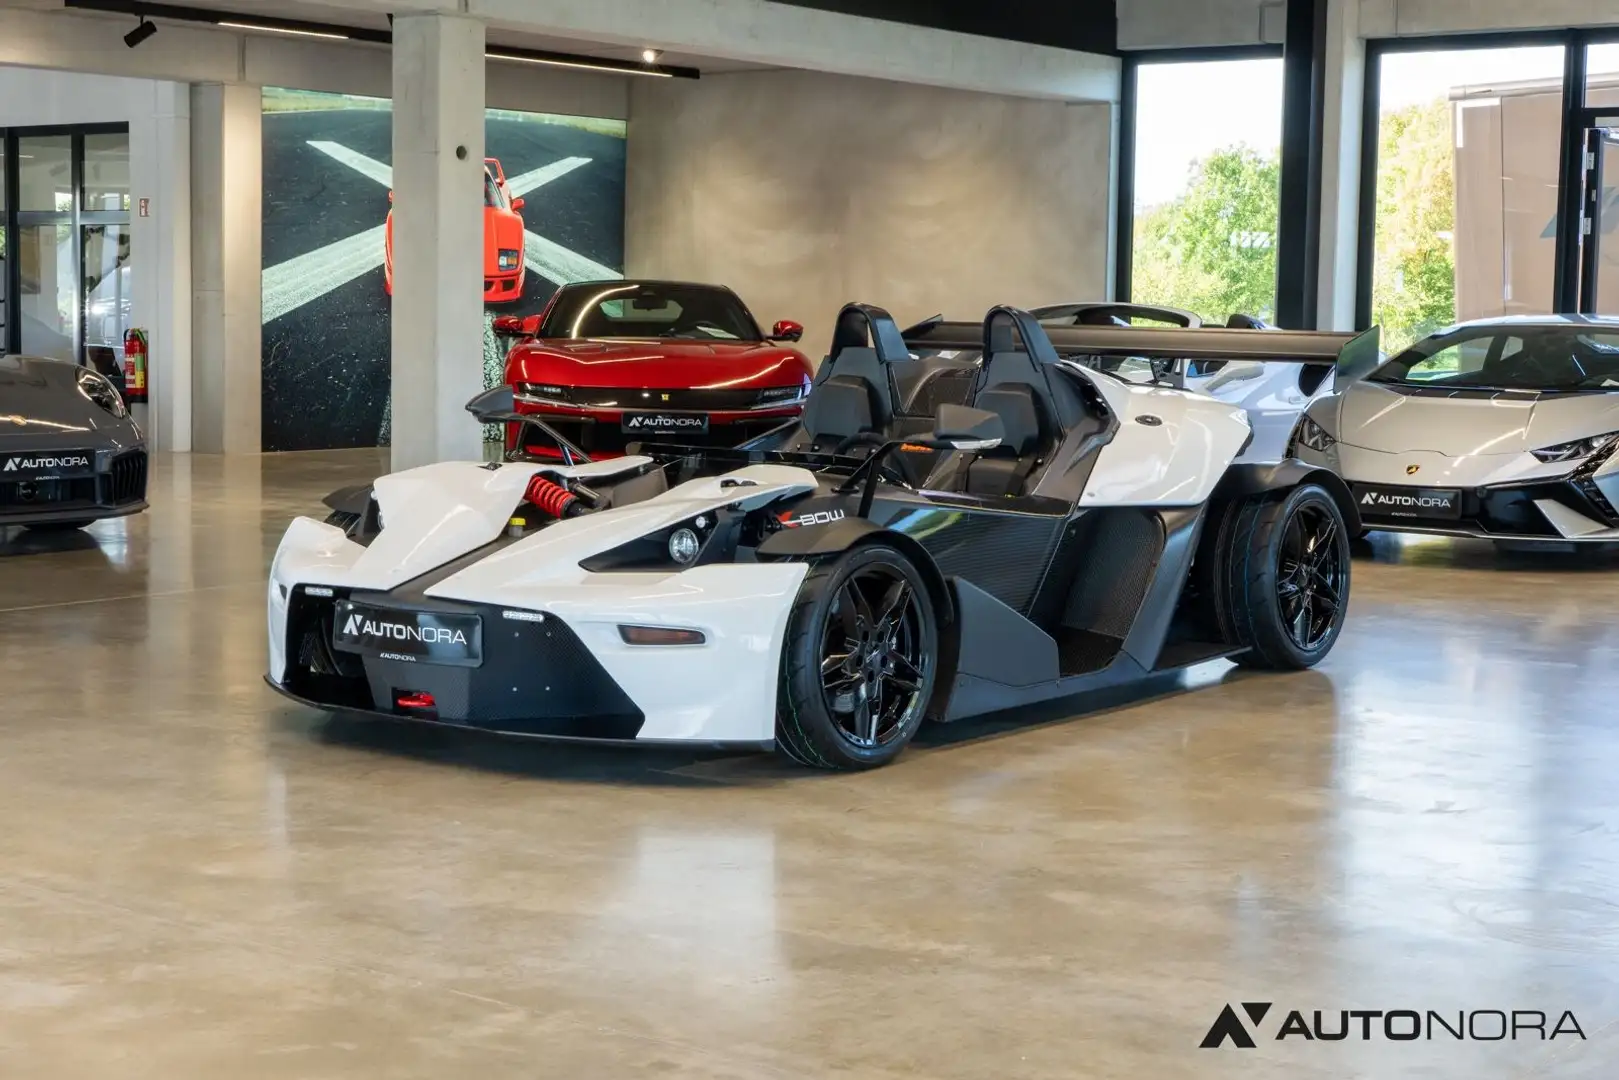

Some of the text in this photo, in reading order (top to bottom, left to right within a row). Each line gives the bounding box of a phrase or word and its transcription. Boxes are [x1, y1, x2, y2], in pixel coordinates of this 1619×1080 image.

[643, 417, 702, 426] AUTONORA
[21, 457, 89, 468] AUTONORA
[1378, 495, 1451, 508] AUTONORA
[362, 620, 467, 645] AUTONORA
